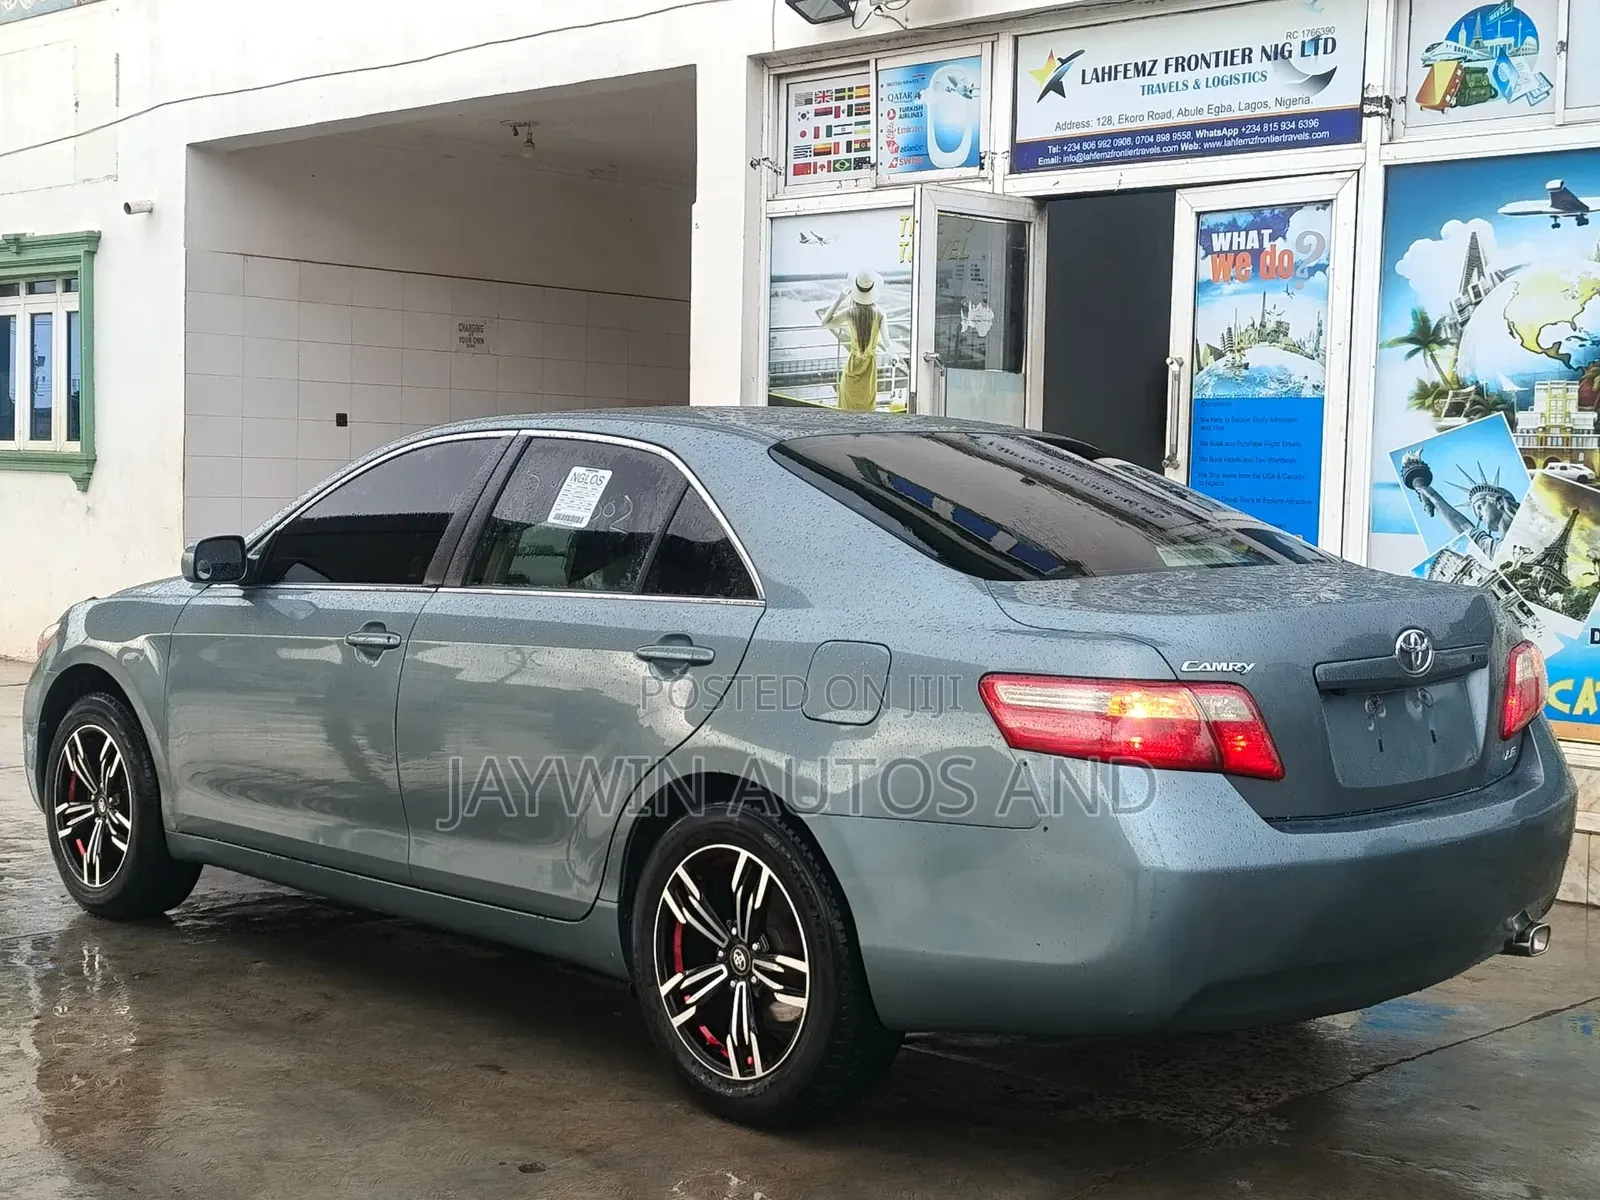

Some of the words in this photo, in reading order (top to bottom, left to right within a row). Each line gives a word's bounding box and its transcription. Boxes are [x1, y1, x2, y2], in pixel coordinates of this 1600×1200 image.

[1285, 31, 1299, 41] RC
[1301, 26, 1336, 39] 1766390
[1081, 58, 1159, 85] LAHFEMZ
[1164, 47, 1254, 75] FRONTIER
[1260, 42, 1293, 63] NIG
[1300, 36, 1337, 58] LTD
[1140, 79, 1189, 96] TRAVELS
[1192, 78, 1202, 90] &
[1205, 69, 1268, 89] LOGISTICS
[887, 91, 913, 102] QATAR
[898, 105, 924, 114] TURKISH
[898, 111, 924, 120] AIRLINES
[1054, 119, 1093, 132] Address:
[1096, 115, 1115, 127] 128,
[1118, 113, 1145, 125] Ekoro
[1147, 109, 1175, 121] Road,
[1176, 105, 1204, 118] Abule
[1207, 102, 1235, 117] Egba,
[1238, 99, 1271, 113] Lagos,
[1275, 94, 1314, 109] Nigeria.
[1048, 145, 1061, 154] Tel:
[1063, 143, 1080, 152] +234
[1135, 135, 1154, 145] 0704
[1195, 126, 1239, 140] WhatsApp
[1240, 124, 1261, 134] +234
[1262, 121, 1279, 132] 815
[1280, 120, 1296, 131] 934
[1298, 118, 1320, 129] 6396
[1038, 155, 1061, 166] Email:
[1062, 144, 1179, 164] info@lahfemzfrontiertravels.com
[1180, 142, 1201, 152] Web:
[1203, 130, 1330, 149] www.lahfemzfrontiertravels.com
[1211, 228, 1273, 252] WHAT
[1210, 251, 1252, 283] we
[458, 322, 485, 334] CHARGING
[569, 471, 606, 487] NGLOS
[1180, 660, 1257, 675] CAMRY
[1501, 745, 1517, 761] LE
